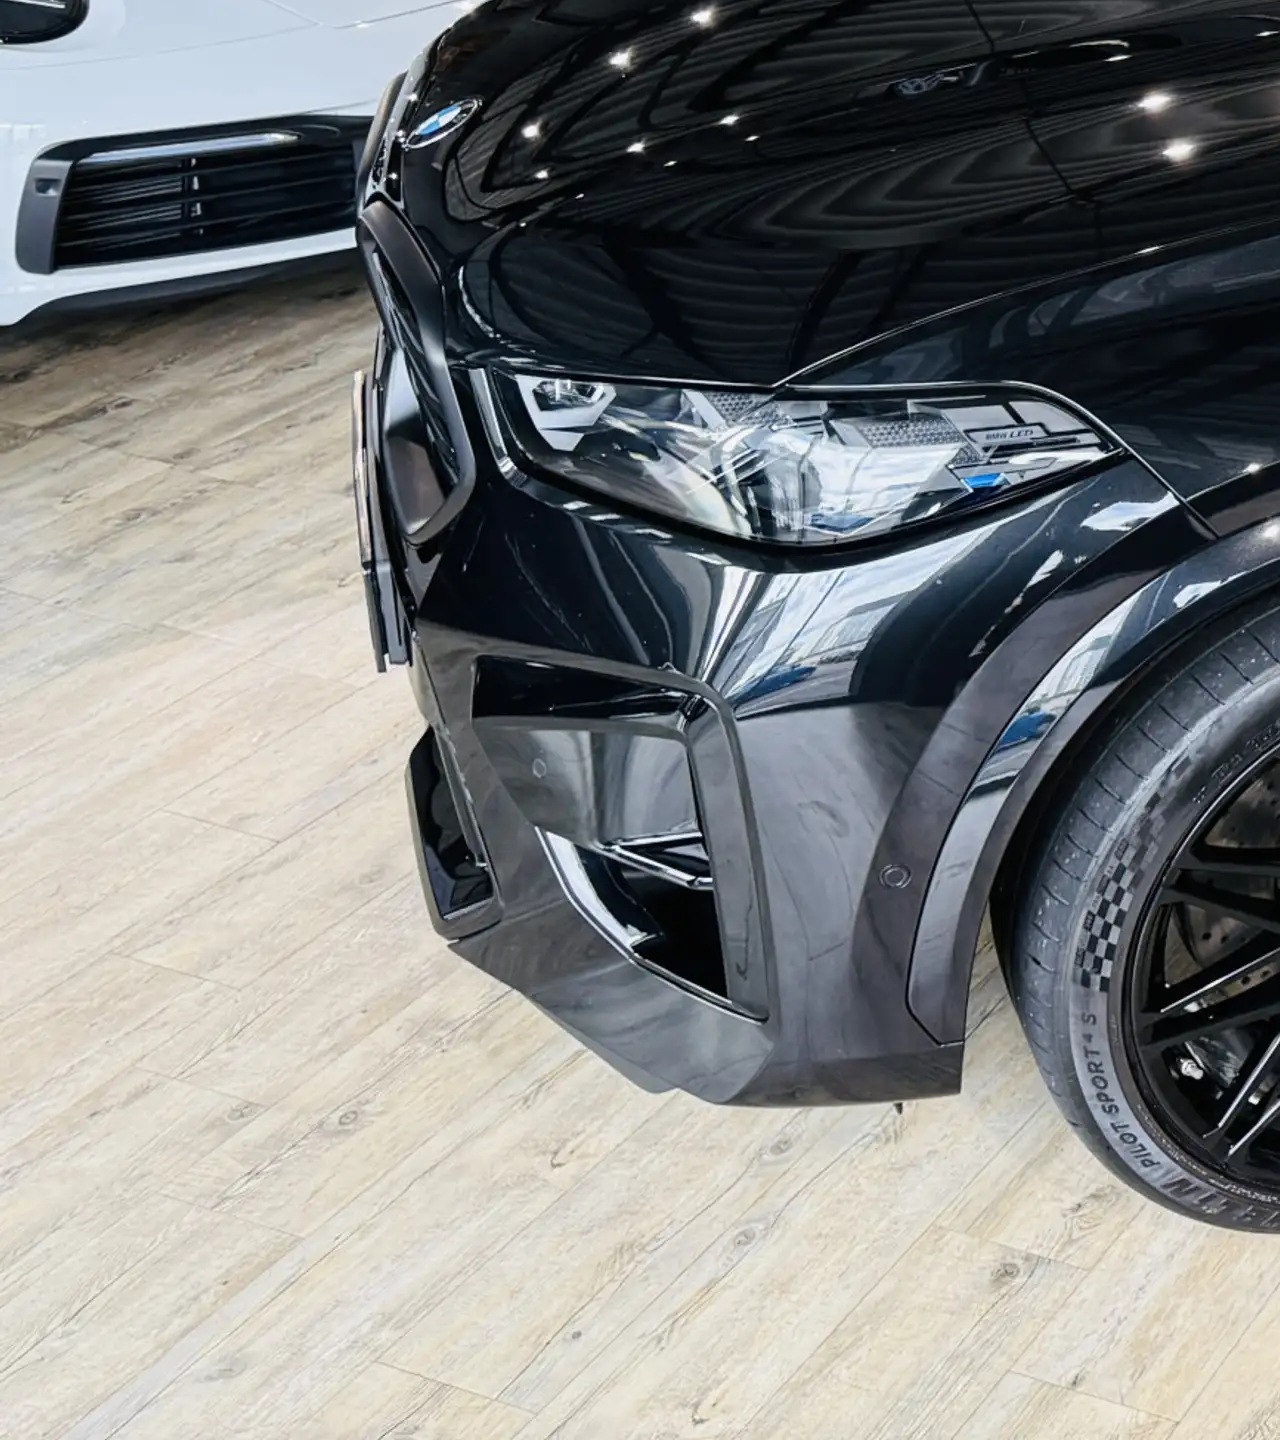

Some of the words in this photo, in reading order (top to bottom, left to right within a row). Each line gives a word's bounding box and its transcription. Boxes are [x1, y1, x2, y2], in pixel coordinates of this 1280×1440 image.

[1081, 1011, 1097, 1026] S
[1083, 1045, 1120, 1115] SPORT
[1110, 1121, 1160, 1168] PILOT
